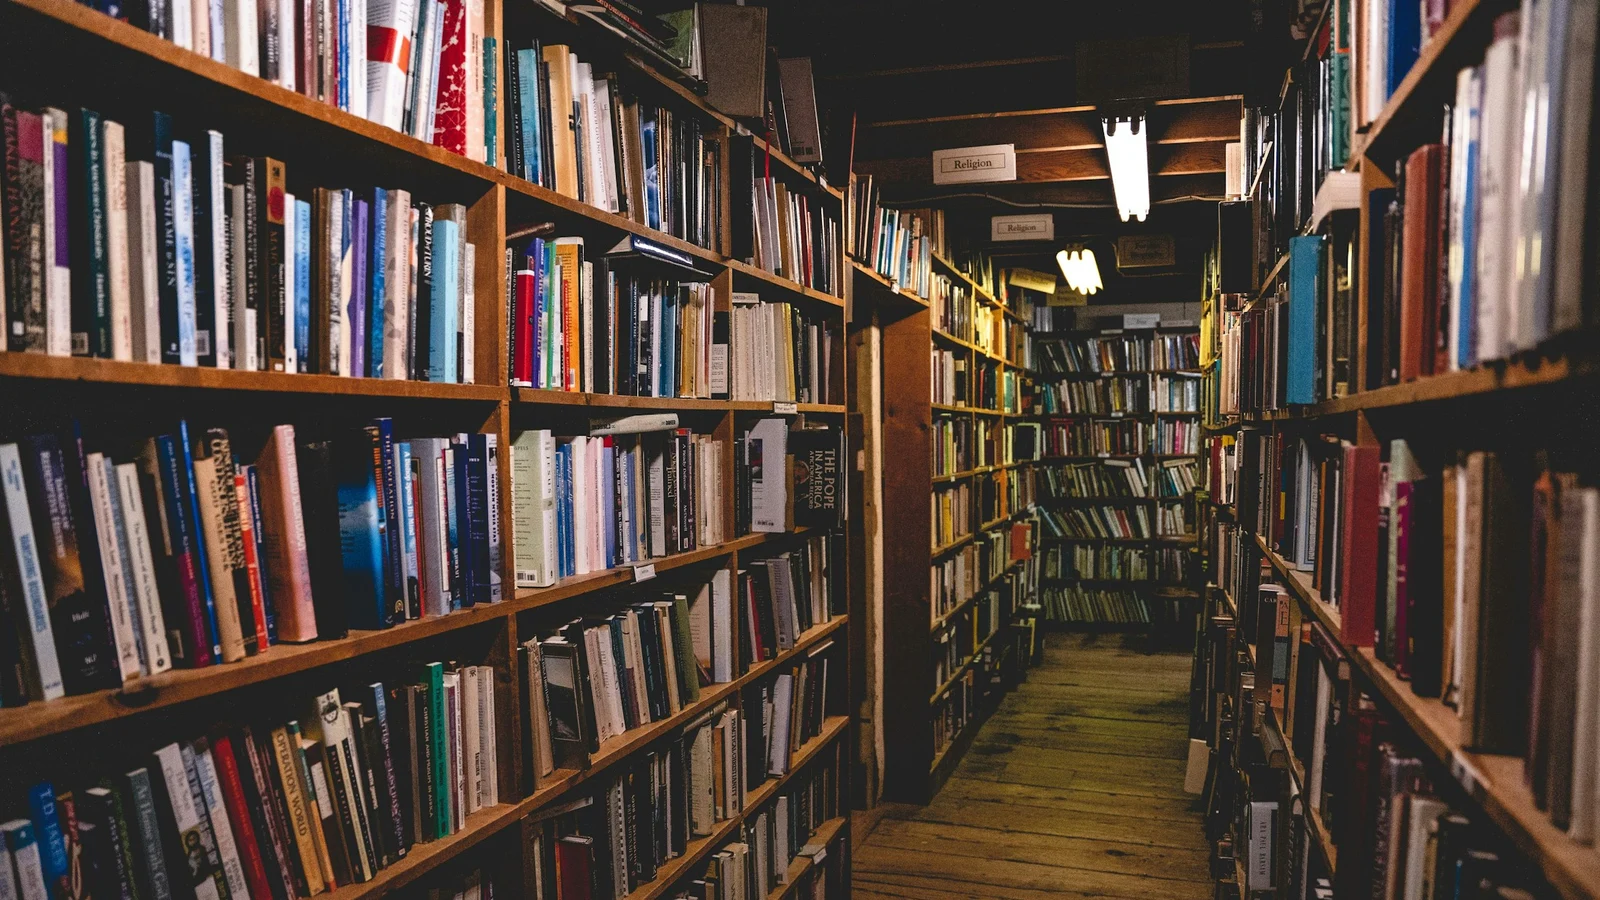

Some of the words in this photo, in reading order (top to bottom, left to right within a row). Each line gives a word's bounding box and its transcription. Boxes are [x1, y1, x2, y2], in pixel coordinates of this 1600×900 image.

[954, 158, 992, 171] Religion
[91, 163, 100, 206] American
[163, 198, 173, 242] SHAME
[1007, 223, 1037, 234] Religion
[270, 231, 278, 265] MARY
[166, 261, 175, 286] SIN
[182, 236, 190, 293] WAKING
[423, 251, 431, 277] TURIN
[185, 300, 191, 318] UP
[537, 300, 542, 314] TO
[815, 450, 823, 461] IN
[824, 448, 835, 473] THE
[287, 454, 300, 494] HUBBARD
[403, 458, 411, 480] Bishop
[209, 479, 219, 508] GOD
[386, 459, 395, 519] REVELATION
[404, 481, 412, 505] Speaks
[814, 464, 823, 509] AMERICA
[823, 478, 834, 509] POPE
[375, 686, 384, 707] EPIC
[729, 717, 737, 751] PRACTICAL
[273, 733, 296, 795] OPERATION
[289, 795, 307, 836] WORLD
[437, 762, 445, 786] Fathers
[729, 751, 738, 797] CHRISTIANITY
[1258, 836, 1266, 850] PAUL
